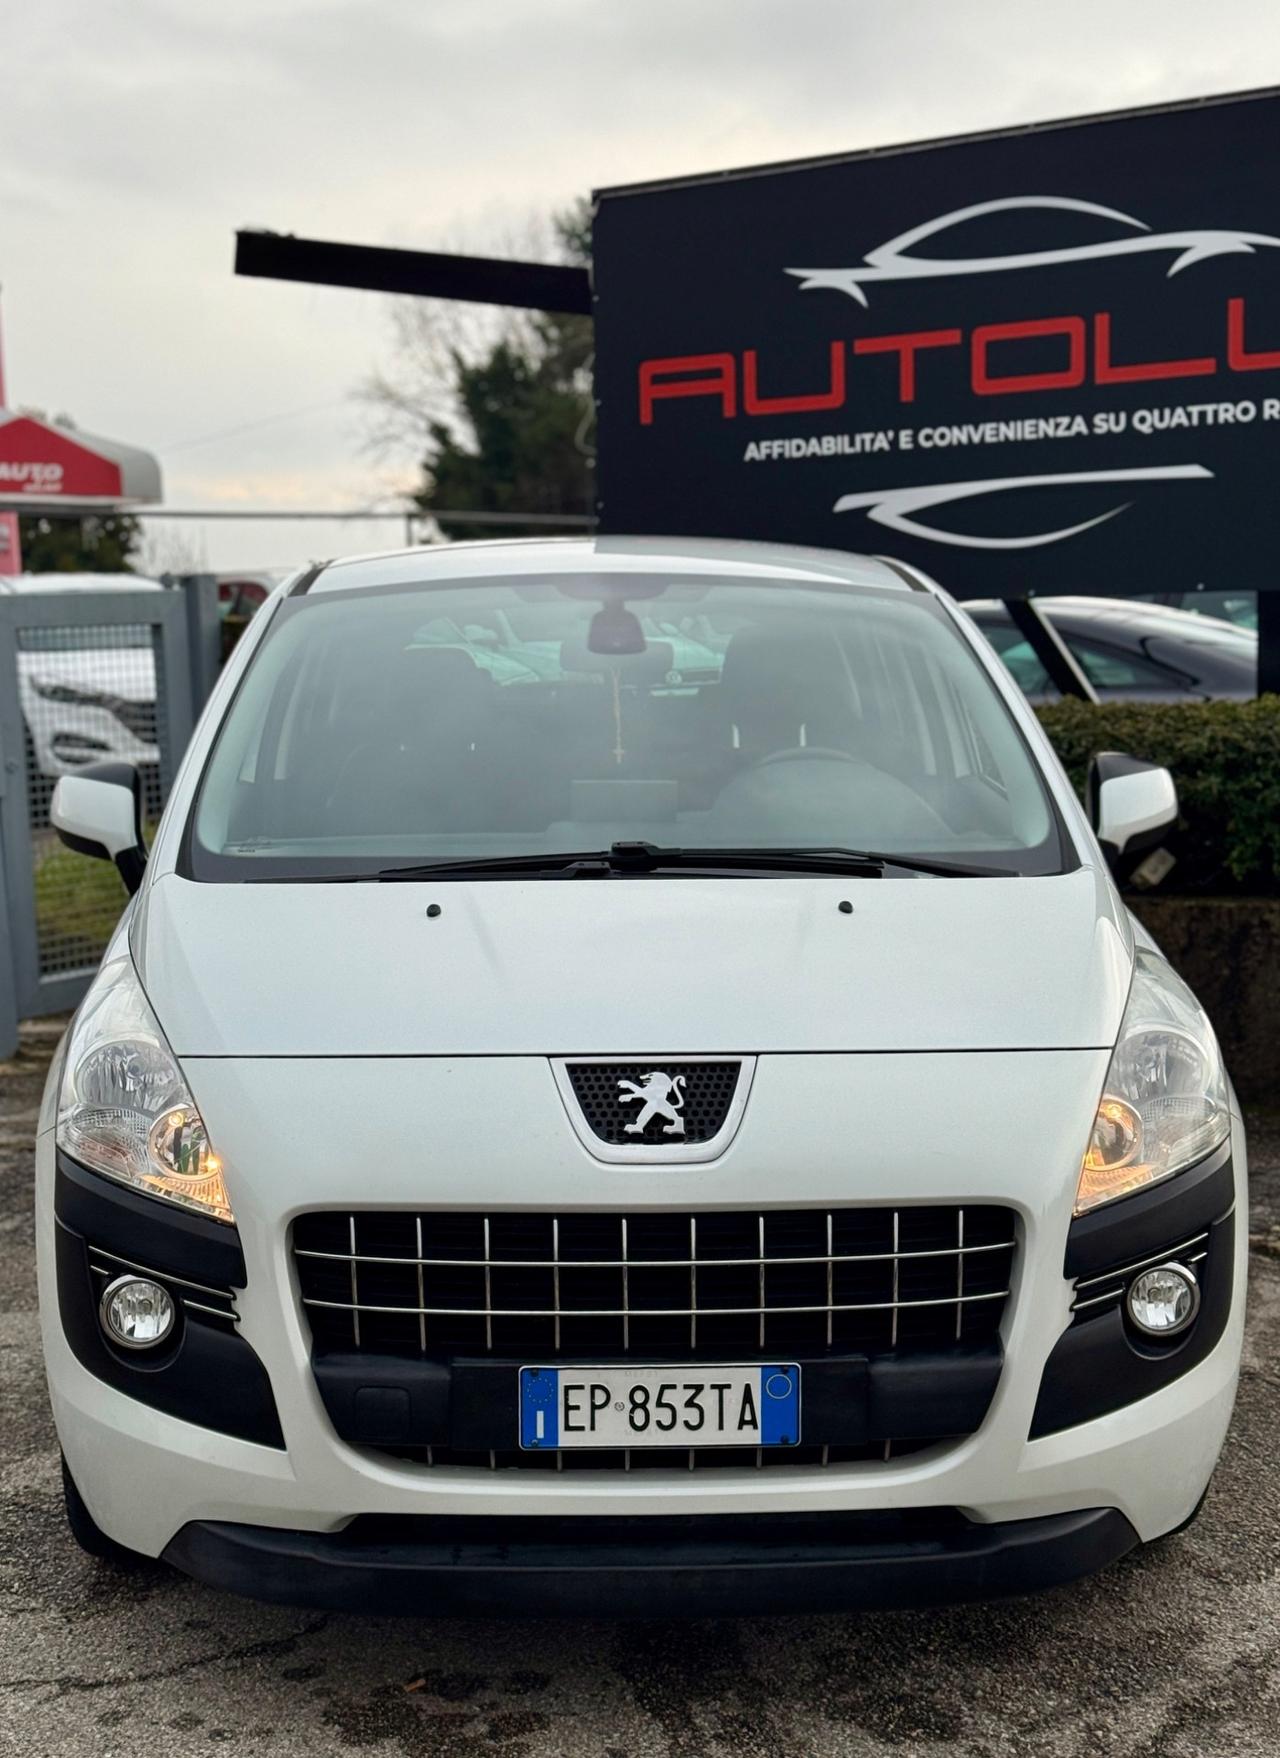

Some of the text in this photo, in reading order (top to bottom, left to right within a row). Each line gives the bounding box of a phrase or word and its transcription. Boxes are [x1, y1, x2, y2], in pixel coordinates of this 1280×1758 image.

[743, 430, 894, 462] AFFIDABILITA'
[898, 429, 913, 450] E
[917, 414, 1089, 448] CONVENIENZA
[1092, 411, 1127, 435] SU
[1131, 400, 1257, 434] QUATTRO
[563, 1383, 758, 1432] EP 853TA
